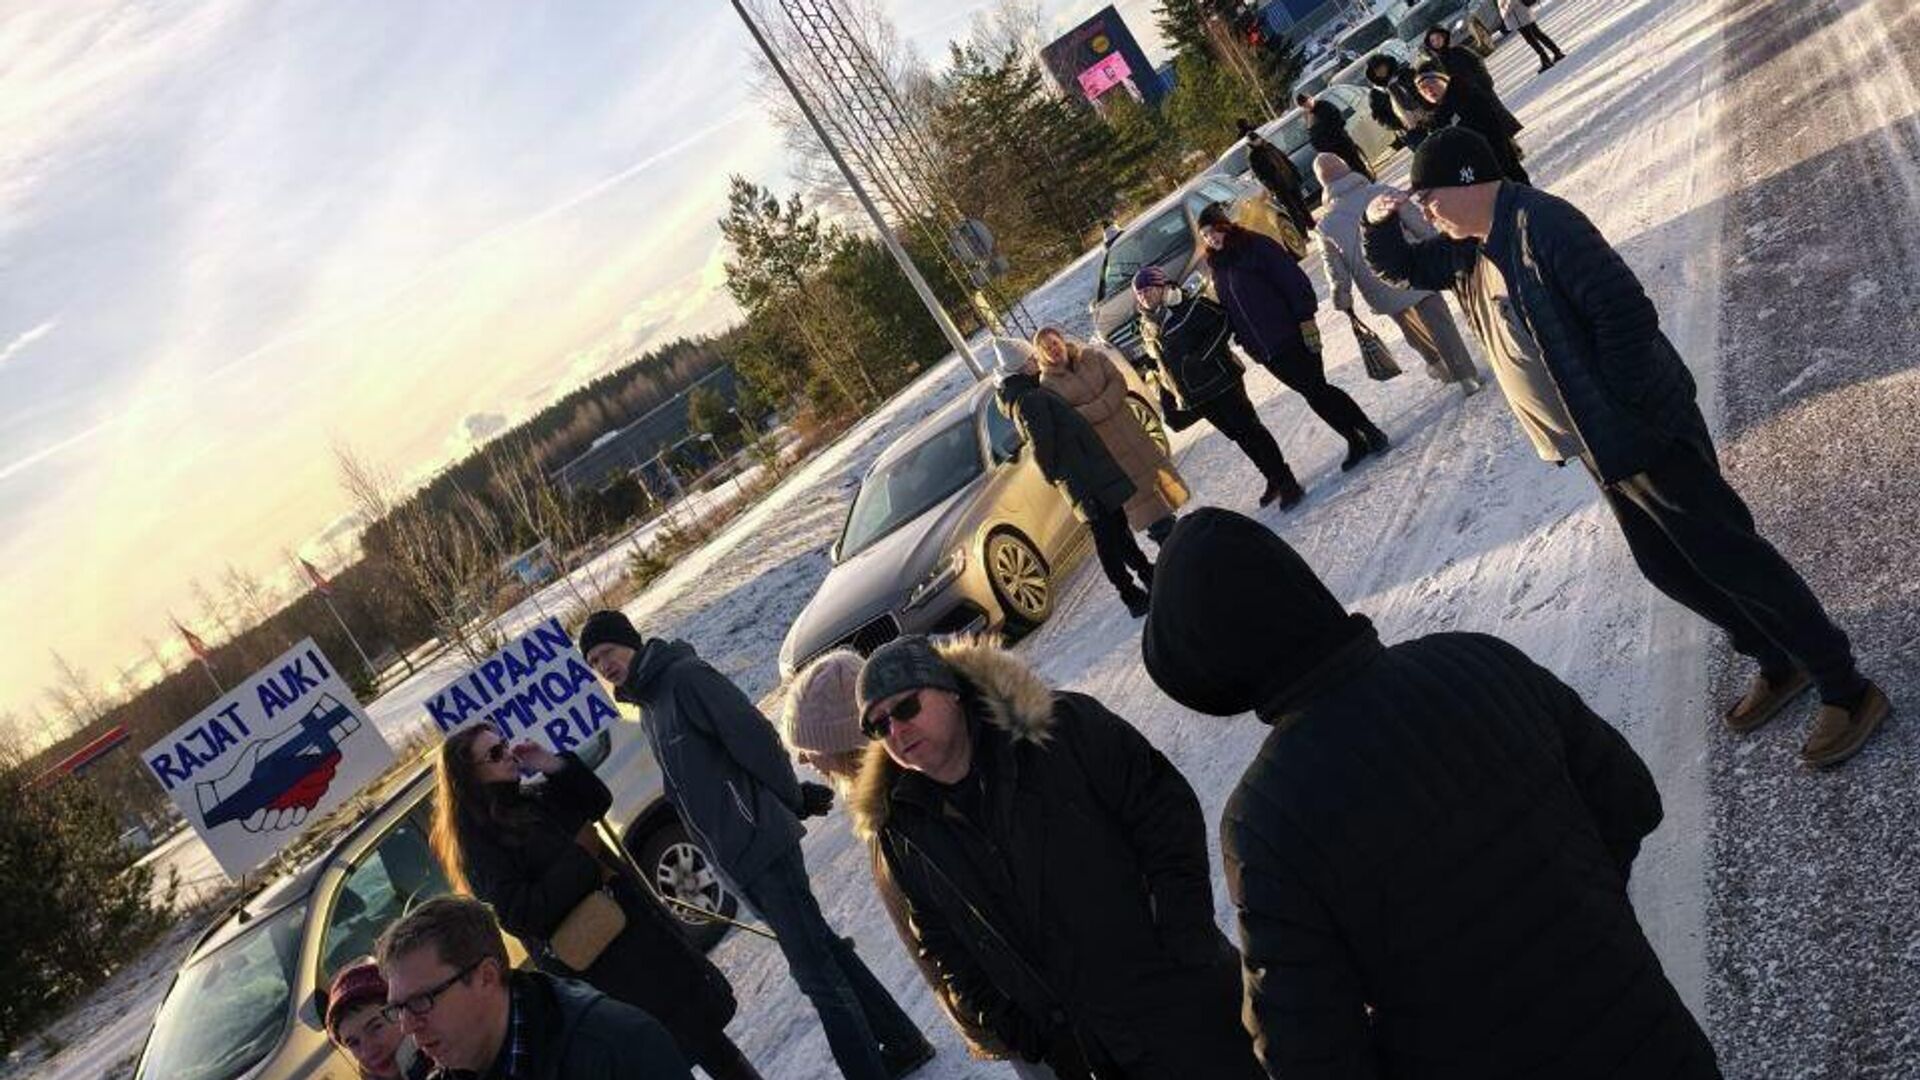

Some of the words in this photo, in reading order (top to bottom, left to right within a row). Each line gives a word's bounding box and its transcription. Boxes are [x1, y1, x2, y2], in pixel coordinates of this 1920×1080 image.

[150, 702, 250, 789] RAJAT
[256, 650, 330, 719] AUKI
[425, 616, 573, 732] KAIPAAN
[484, 657, 598, 740] MMOA
[544, 693, 619, 752] RIA
